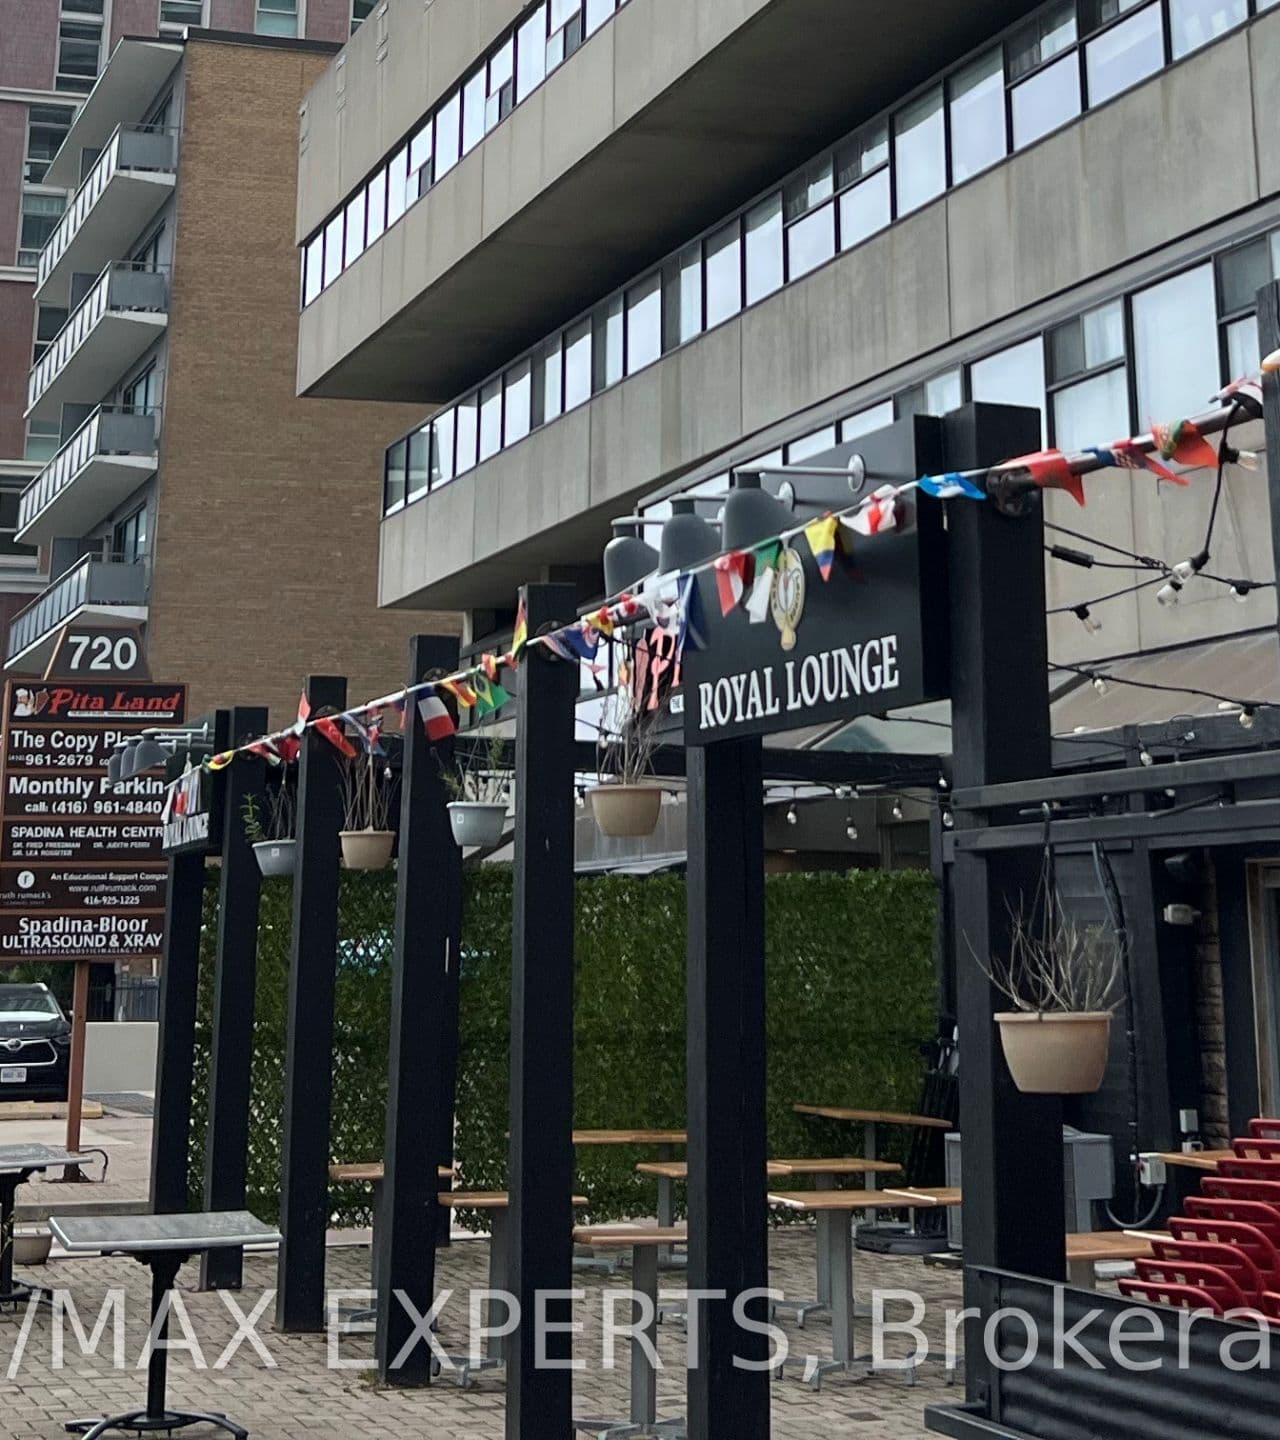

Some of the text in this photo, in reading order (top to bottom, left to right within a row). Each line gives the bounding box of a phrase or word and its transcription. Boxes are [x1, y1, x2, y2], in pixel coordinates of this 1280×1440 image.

[68, 635, 138, 671] 720
[698, 634, 899, 730] ROYAL LOUNGE
[48, 688, 181, 715] Pita Land
[10, 730, 46, 749] The
[50, 730, 99, 753] Copy
[25, 754, 94, 767] 961-2679
[8, 776, 164, 799] Monthly Parkin
[52, 801, 88, 814] (416)
[93, 800, 162, 814] 961-4840
[10, 826, 164, 839] SPADINA HEALTH CENTR
[50, 872, 62, 881] An
[63, 872, 108, 881] Educational
[109, 872, 138, 883] Support
[83, 895, 141, 906] 416-925-1225
[18, 915, 149, 935] Spadina-Bloor
[2, 933, 163, 948] ULTRASOUND & XRAY
